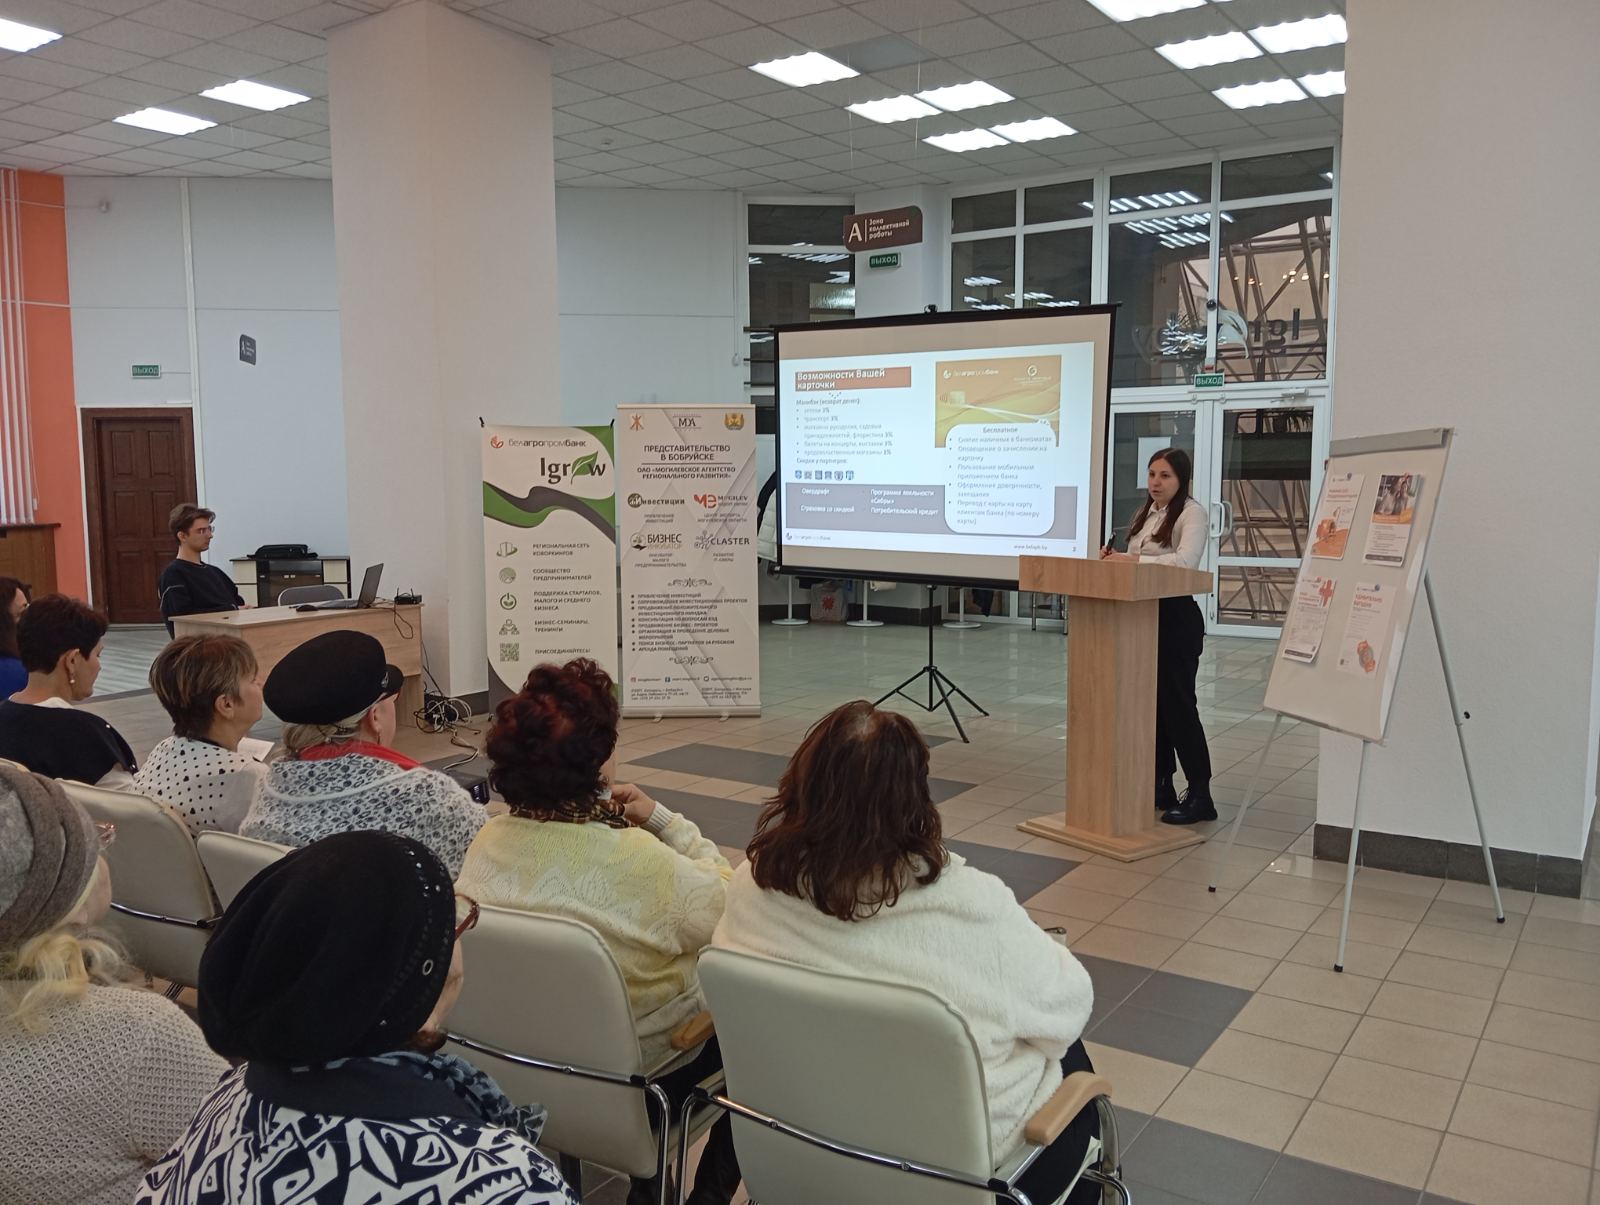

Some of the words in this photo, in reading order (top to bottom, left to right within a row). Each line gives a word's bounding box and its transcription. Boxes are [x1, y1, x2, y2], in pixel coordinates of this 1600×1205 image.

[869, 219, 910, 232] коллективной
[848, 222, 862, 243] А
[870, 255, 897, 265] ВЫХОД
[132, 366, 159, 376] ВЫХОД
[797, 370, 854, 380] Возможности
[856, 368, 885, 378] Вашей
[1196, 375, 1224, 386] ВЫХОД
[797, 381, 835, 391] карточки
[508, 438, 586, 448] белагропромбанк
[644, 444, 730, 453] ПРЕДСТАВИТЕЛЬСТВО
[668, 452, 714, 460] БОБРУЙСКЕ
[647, 533, 682, 544] БИЗНЕС
[710, 537, 750, 546] CLASTER
